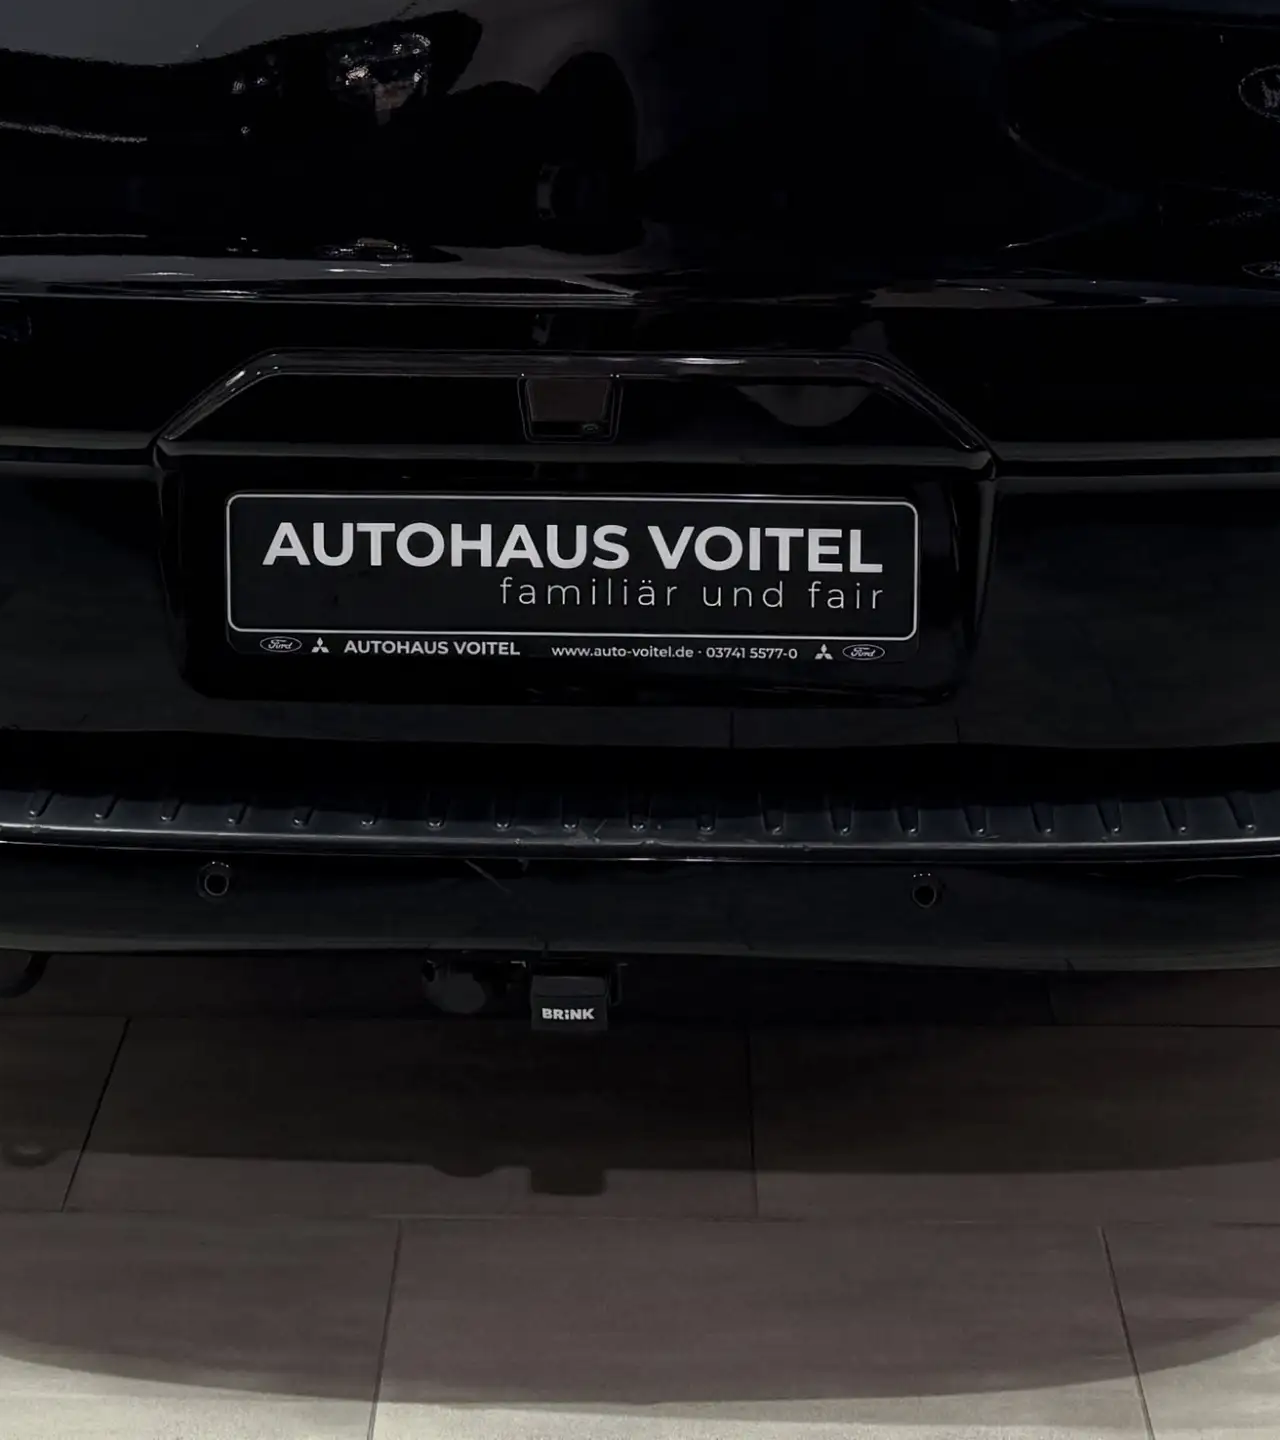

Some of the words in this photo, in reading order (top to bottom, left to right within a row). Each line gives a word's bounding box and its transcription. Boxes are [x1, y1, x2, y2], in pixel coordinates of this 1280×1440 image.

[262, 522, 630, 570] AUTOHAUS
[647, 525, 883, 573] VOITEL
[500, 577, 677, 606] familiär
[703, 581, 783, 608] und
[808, 581, 883, 609] fair
[344, 640, 449, 655] AUTOHAUS
[453, 641, 520, 656] VOITEL
[551, 645, 694, 659] www.auto-voitel.de
[706, 646, 746, 659] 03741
[749, 647, 798, 660] 5577-0
